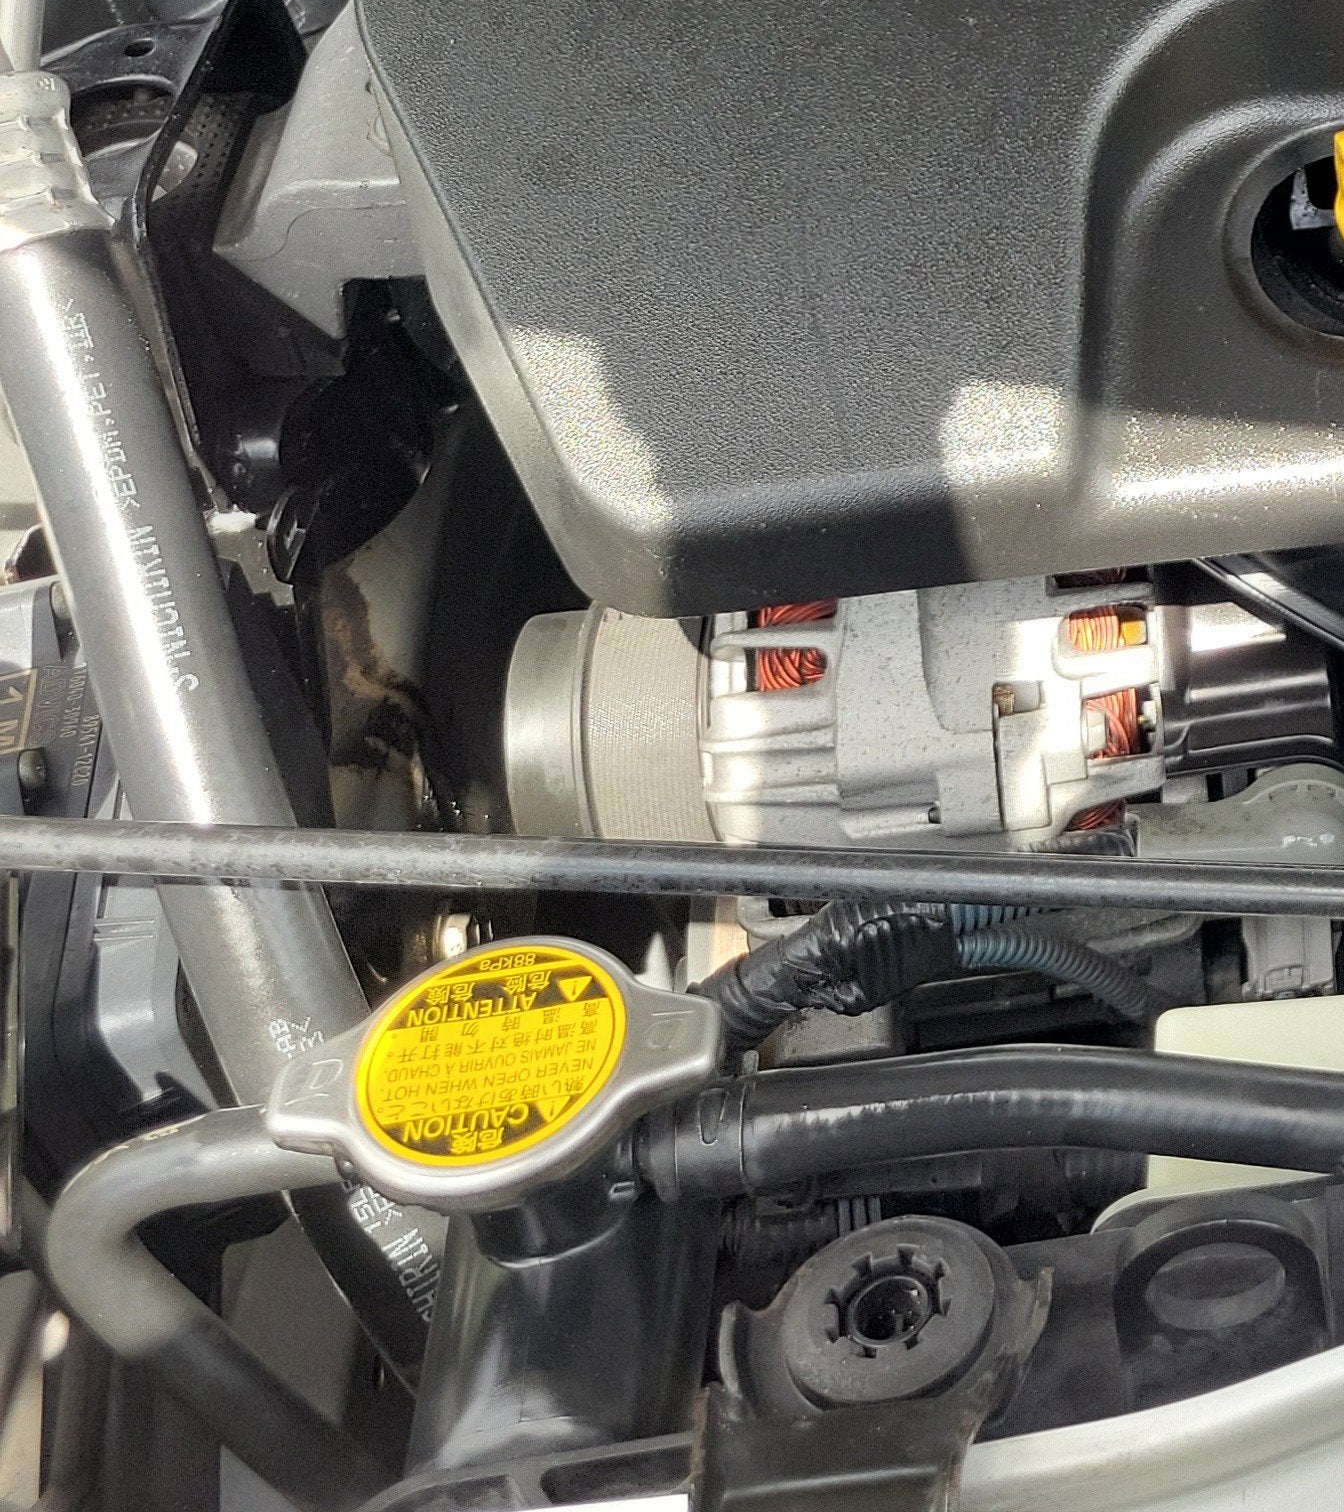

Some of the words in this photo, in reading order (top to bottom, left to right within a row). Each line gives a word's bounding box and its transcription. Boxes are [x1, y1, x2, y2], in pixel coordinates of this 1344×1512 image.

[479, 952, 536, 971] 88kPa
[407, 992, 537, 1028] ATTENTION
[521, 1041, 573, 1063] JAMAIS
[577, 1039, 597, 1053] NE
[460, 1053, 516, 1073] OUVRIR
[536, 1058, 594, 1078] NEVER
[384, 1064, 441, 1082] CHAUD.
[484, 1068, 531, 1087] OPEN
[380, 1083, 421, 1102] HOT.
[426, 1078, 477, 1095] WHEN
[403, 1103, 529, 1143] CAUTION
